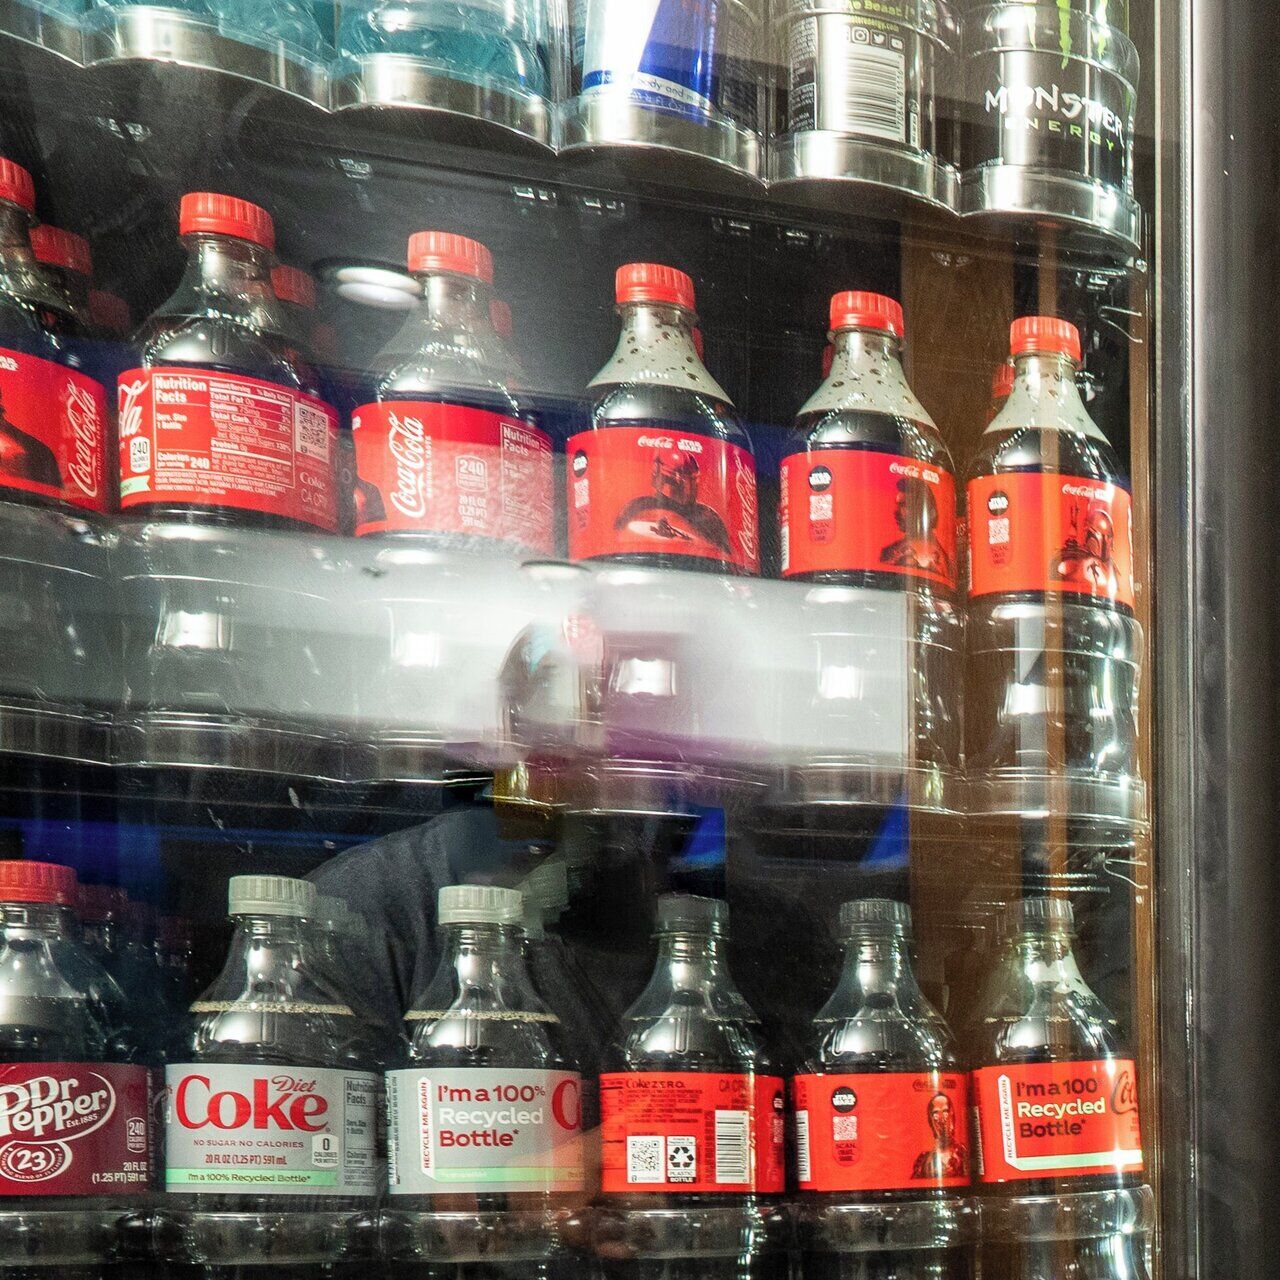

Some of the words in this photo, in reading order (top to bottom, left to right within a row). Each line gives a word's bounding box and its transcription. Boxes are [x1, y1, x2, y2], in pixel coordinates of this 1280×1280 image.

[985, 84, 1124, 147] MONSTER
[156, 377, 207, 392] Nutrition
[156, 390, 187, 403] Facts
[29, 1076, 78, 1108] Dr
[271, 1075, 317, 1093] Diet
[437, 1085, 472, 1102] I'm
[474, 1089, 490, 1102] a
[492, 1084, 546, 1102] 100%
[175, 1074, 329, 1132] Coke
[421, 1081, 429, 1113] AGAIN
[1017, 1097, 1106, 1118] Recycled
[422, 1115, 429, 1127] ME
[439, 1107, 543, 1128] Recycled
[207, 1140, 236, 1148] SUGAR
[256, 1140, 304, 1148] CALORIES
[422, 1129, 430, 1170] RECYCLE
[17, 1150, 46, 1171] 23
